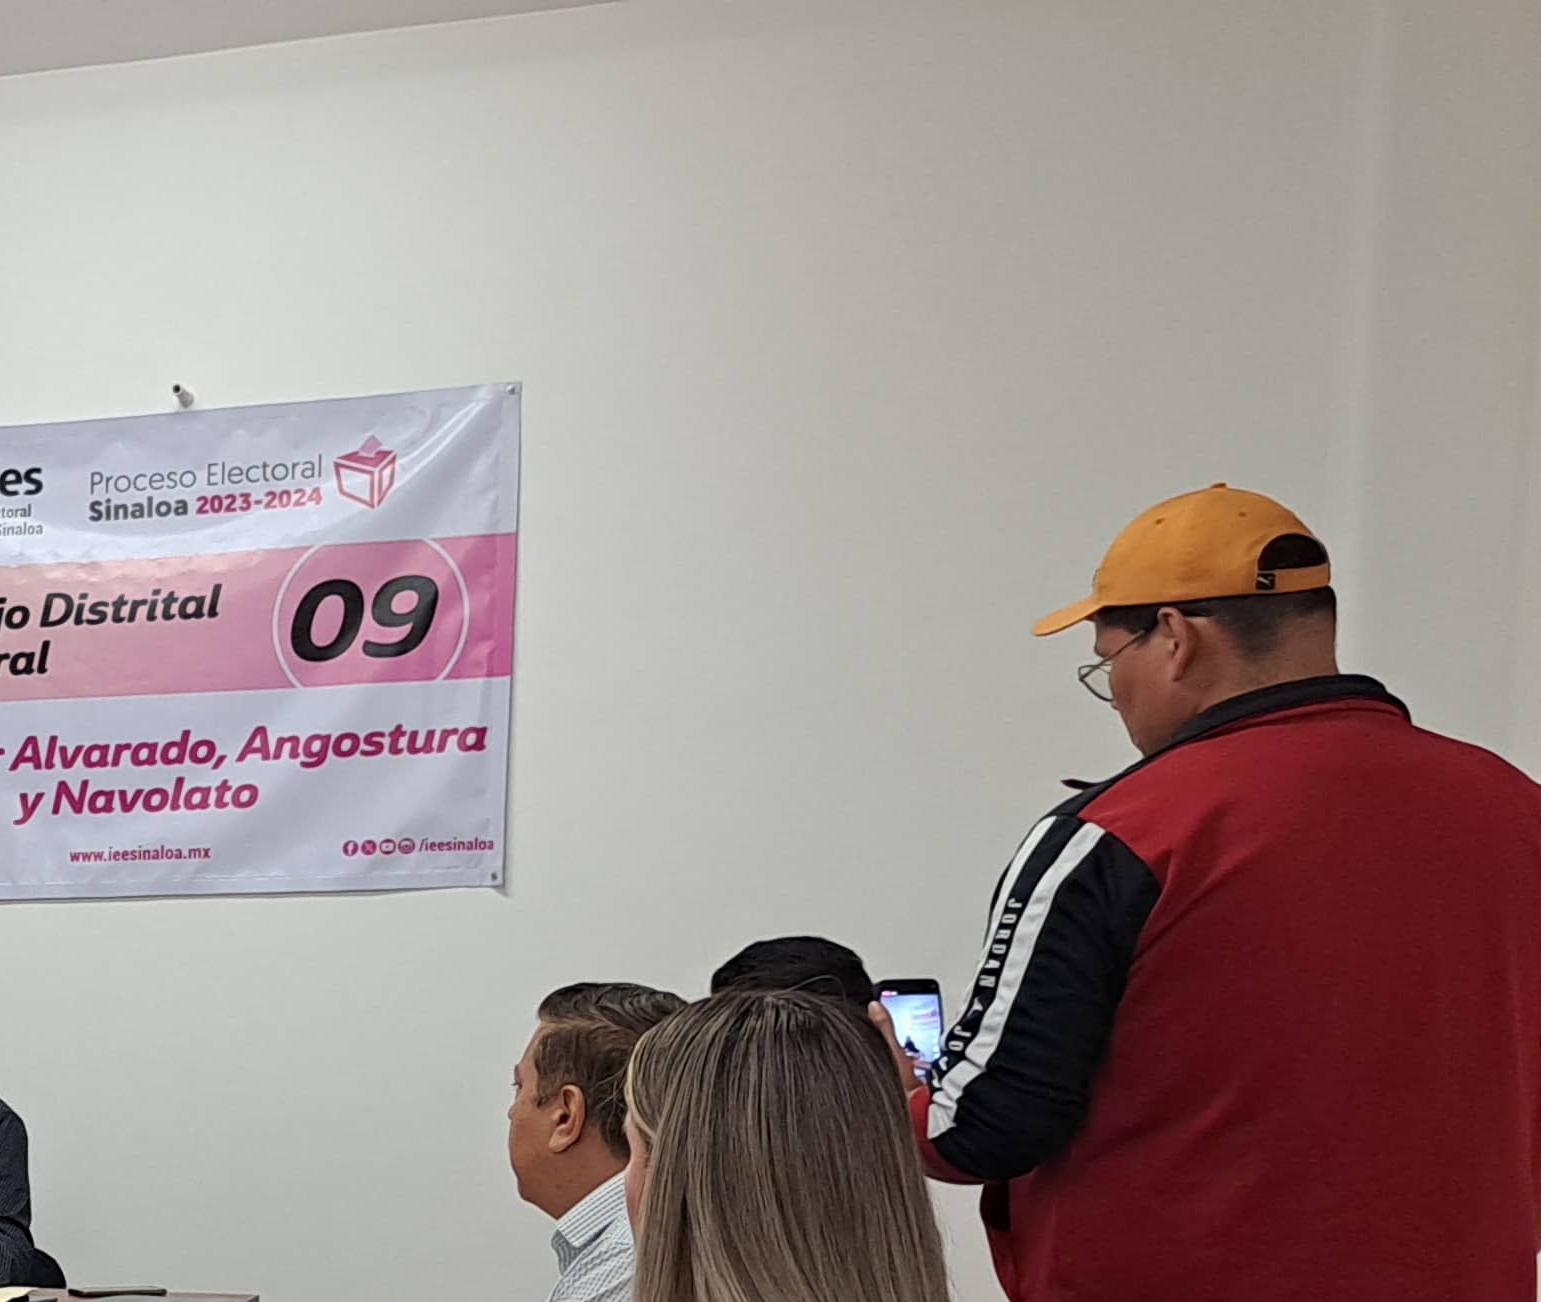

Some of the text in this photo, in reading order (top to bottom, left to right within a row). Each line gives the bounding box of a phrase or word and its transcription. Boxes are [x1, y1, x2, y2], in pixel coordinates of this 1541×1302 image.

[90, 453, 323, 495] Proceso Electoral
[88, 487, 323, 522] Sinaloa 2023-2024
[39, 583, 222, 628] Distrital
[290, 575, 439, 662] 09
[8, 729, 227, 771] Alvarado,
[235, 724, 488, 768] Angostura
[13, 776, 259, 825] y Navolato
[69, 845, 211, 863] www.ieesinaloa.mx
[419, 836, 494, 853] /ieesinaloa
[979, 898, 1022, 988] JORDAN
